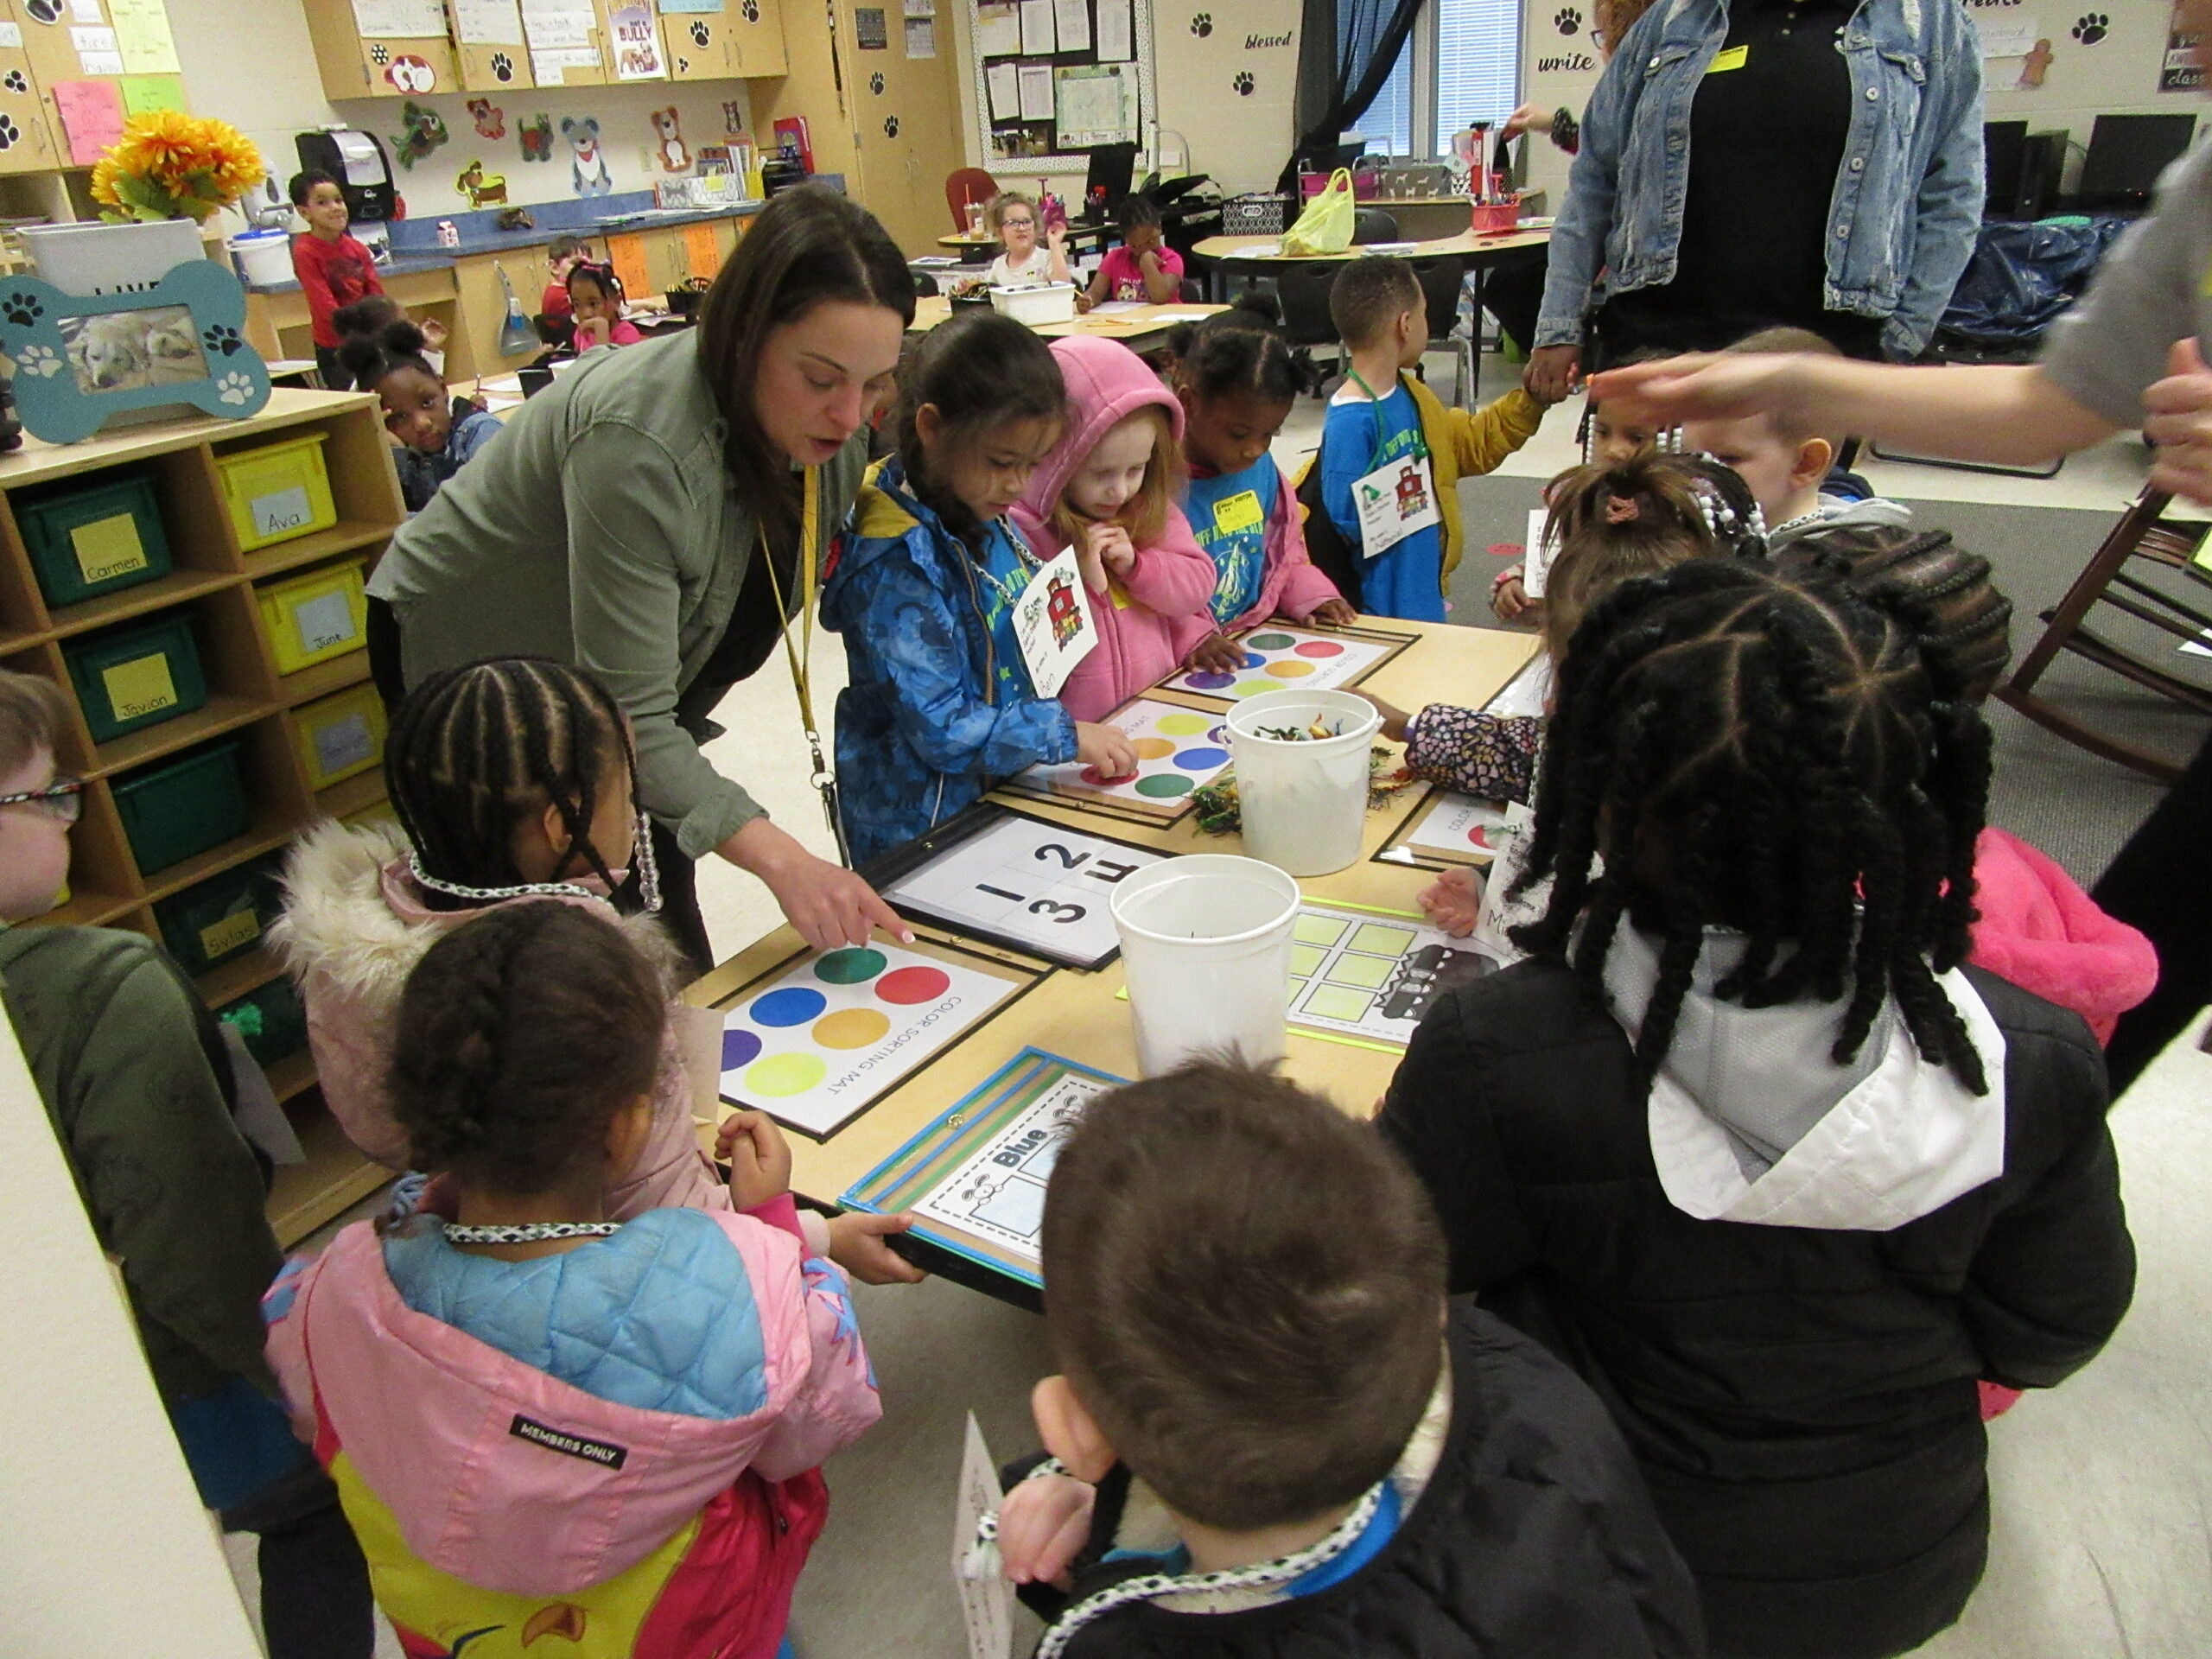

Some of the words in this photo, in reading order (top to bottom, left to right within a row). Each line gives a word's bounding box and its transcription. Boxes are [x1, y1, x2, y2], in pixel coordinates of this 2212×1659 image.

[619, 25, 652, 42] BULLY
[1245, 31, 1292, 49] blessed
[1538, 52, 1595, 72] write
[1234, 492, 1253, 504] VISITOR
[268, 513, 301, 532] Ava
[86, 556, 141, 581] Carmen
[313, 632, 342, 649] June
[1039, 672, 1056, 699] Ben
[121, 694, 168, 718] Javion
[1033, 842, 1093, 870] 2
[1027, 899, 1088, 925] 3
[1083, 859, 1141, 884] 4
[917, 995, 963, 1029] COLOR
[857, 1027, 920, 1071] SORTING
[826, 1070, 861, 1096] MAT
[992, 1128, 1048, 1168] Blue
[520, 1423, 582, 1452] MEMBERS
[582, 1444, 617, 1463] ONLY
